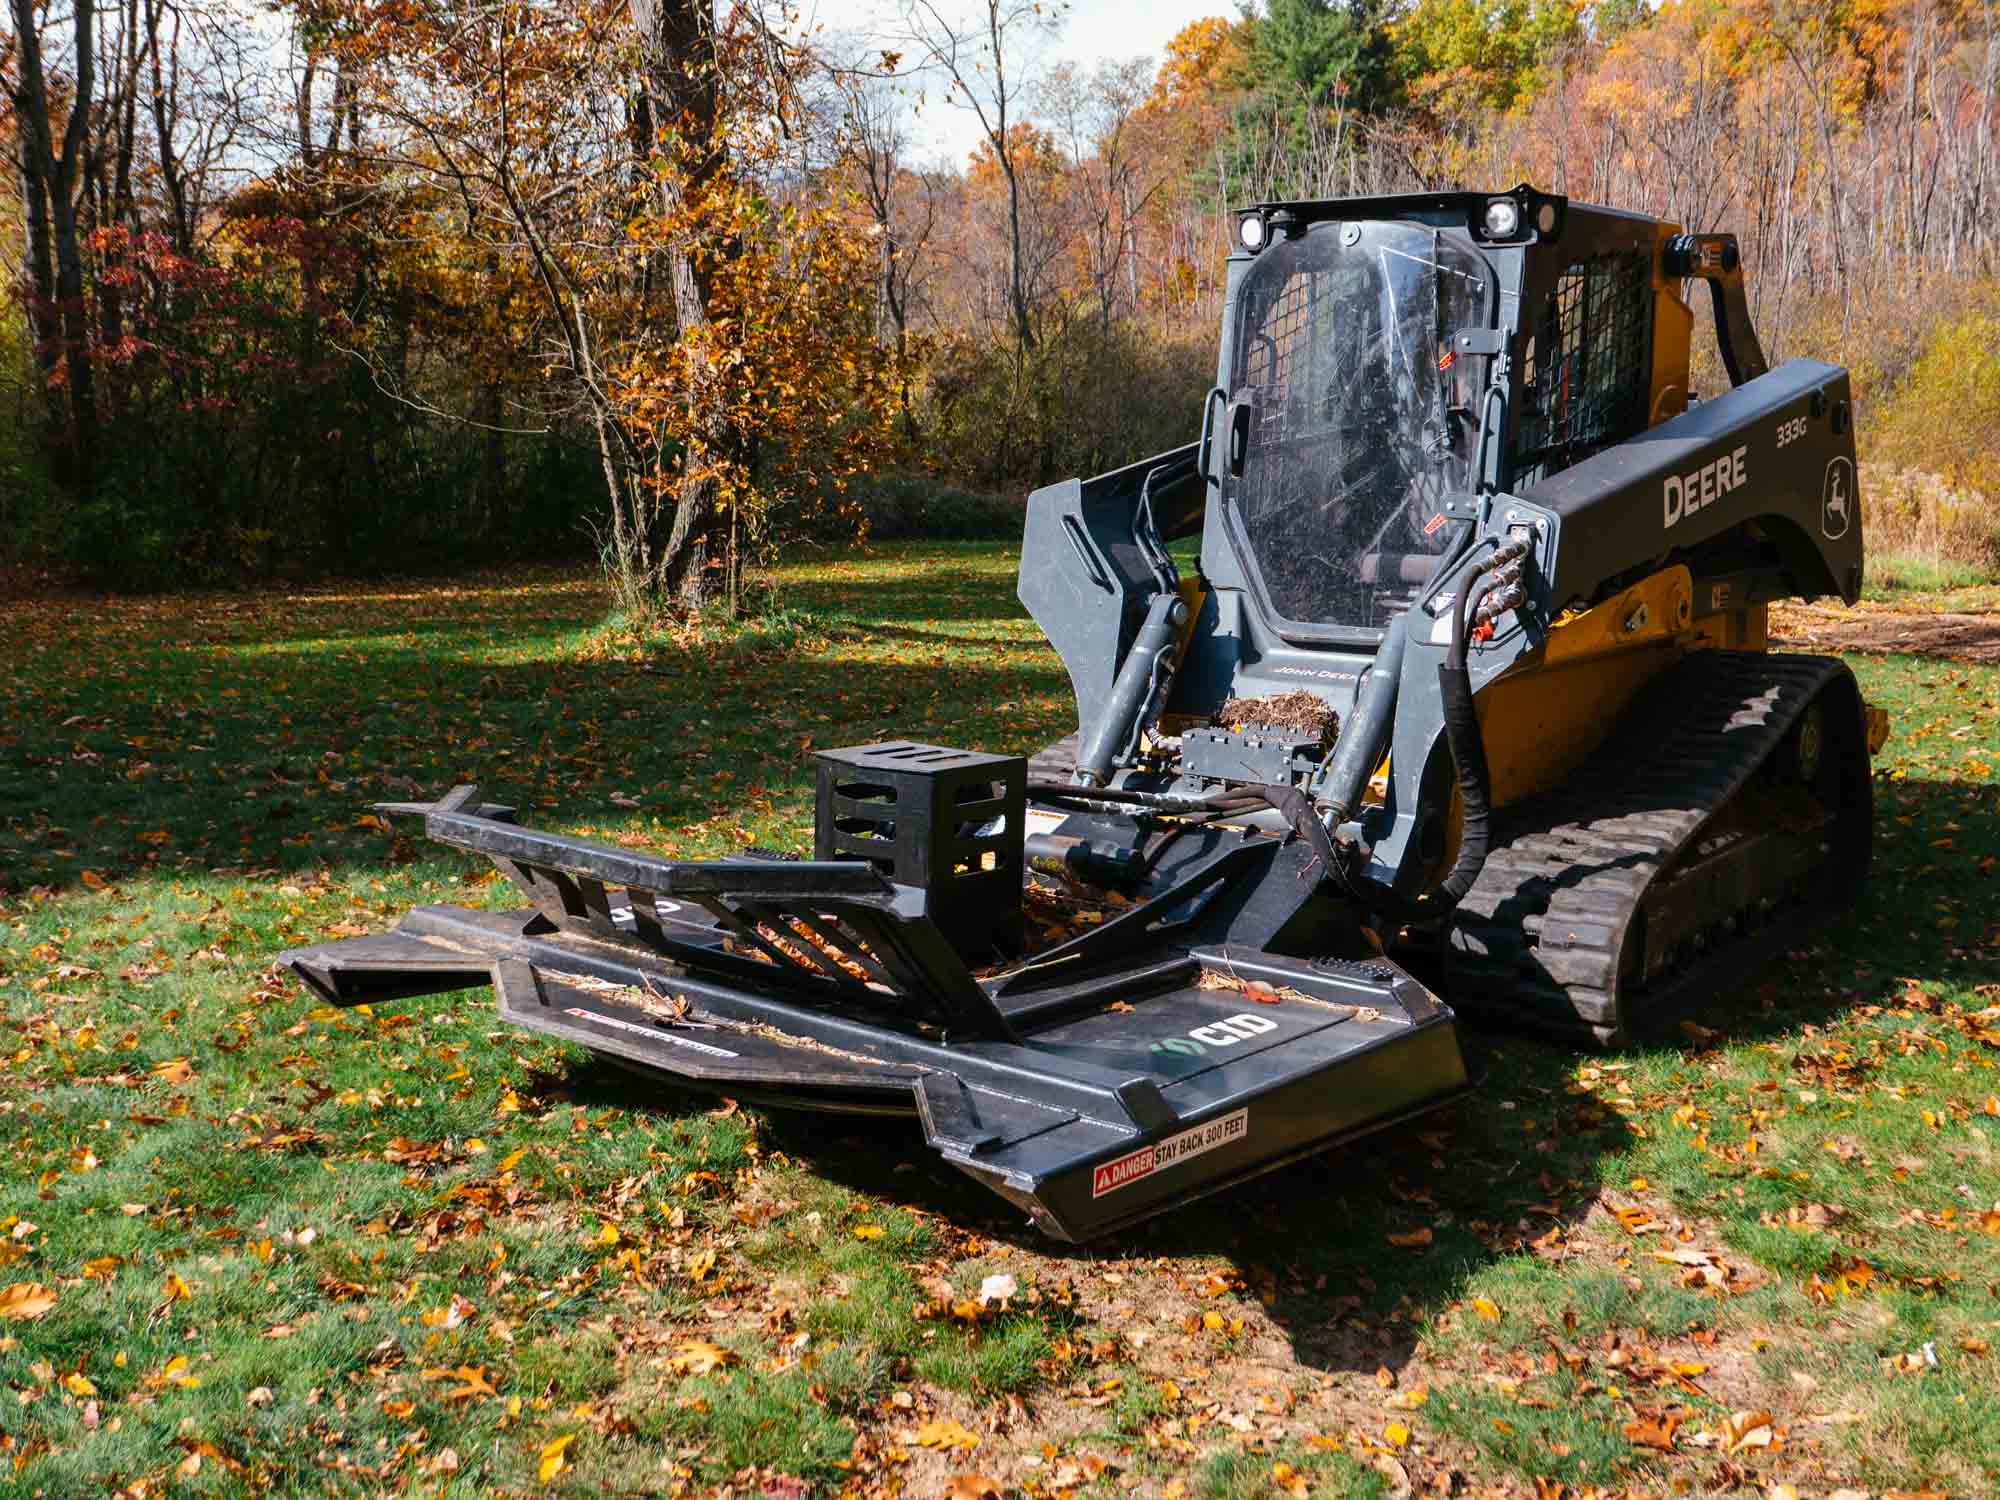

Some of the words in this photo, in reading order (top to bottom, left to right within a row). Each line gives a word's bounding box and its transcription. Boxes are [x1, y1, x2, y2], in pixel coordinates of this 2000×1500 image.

[1776, 416, 1807, 448] 333G
[1664, 445, 1747, 528] DEERE
[1274, 666, 1316, 676] JOHN
[1188, 1013, 1278, 1046] CID
[1112, 1150, 1153, 1184] DANGER
[1155, 1141, 1178, 1164] STAY
[1180, 1133, 1204, 1154] BACK
[1206, 1126, 1222, 1145] 300
[1224, 1115, 1245, 1138] FEET
